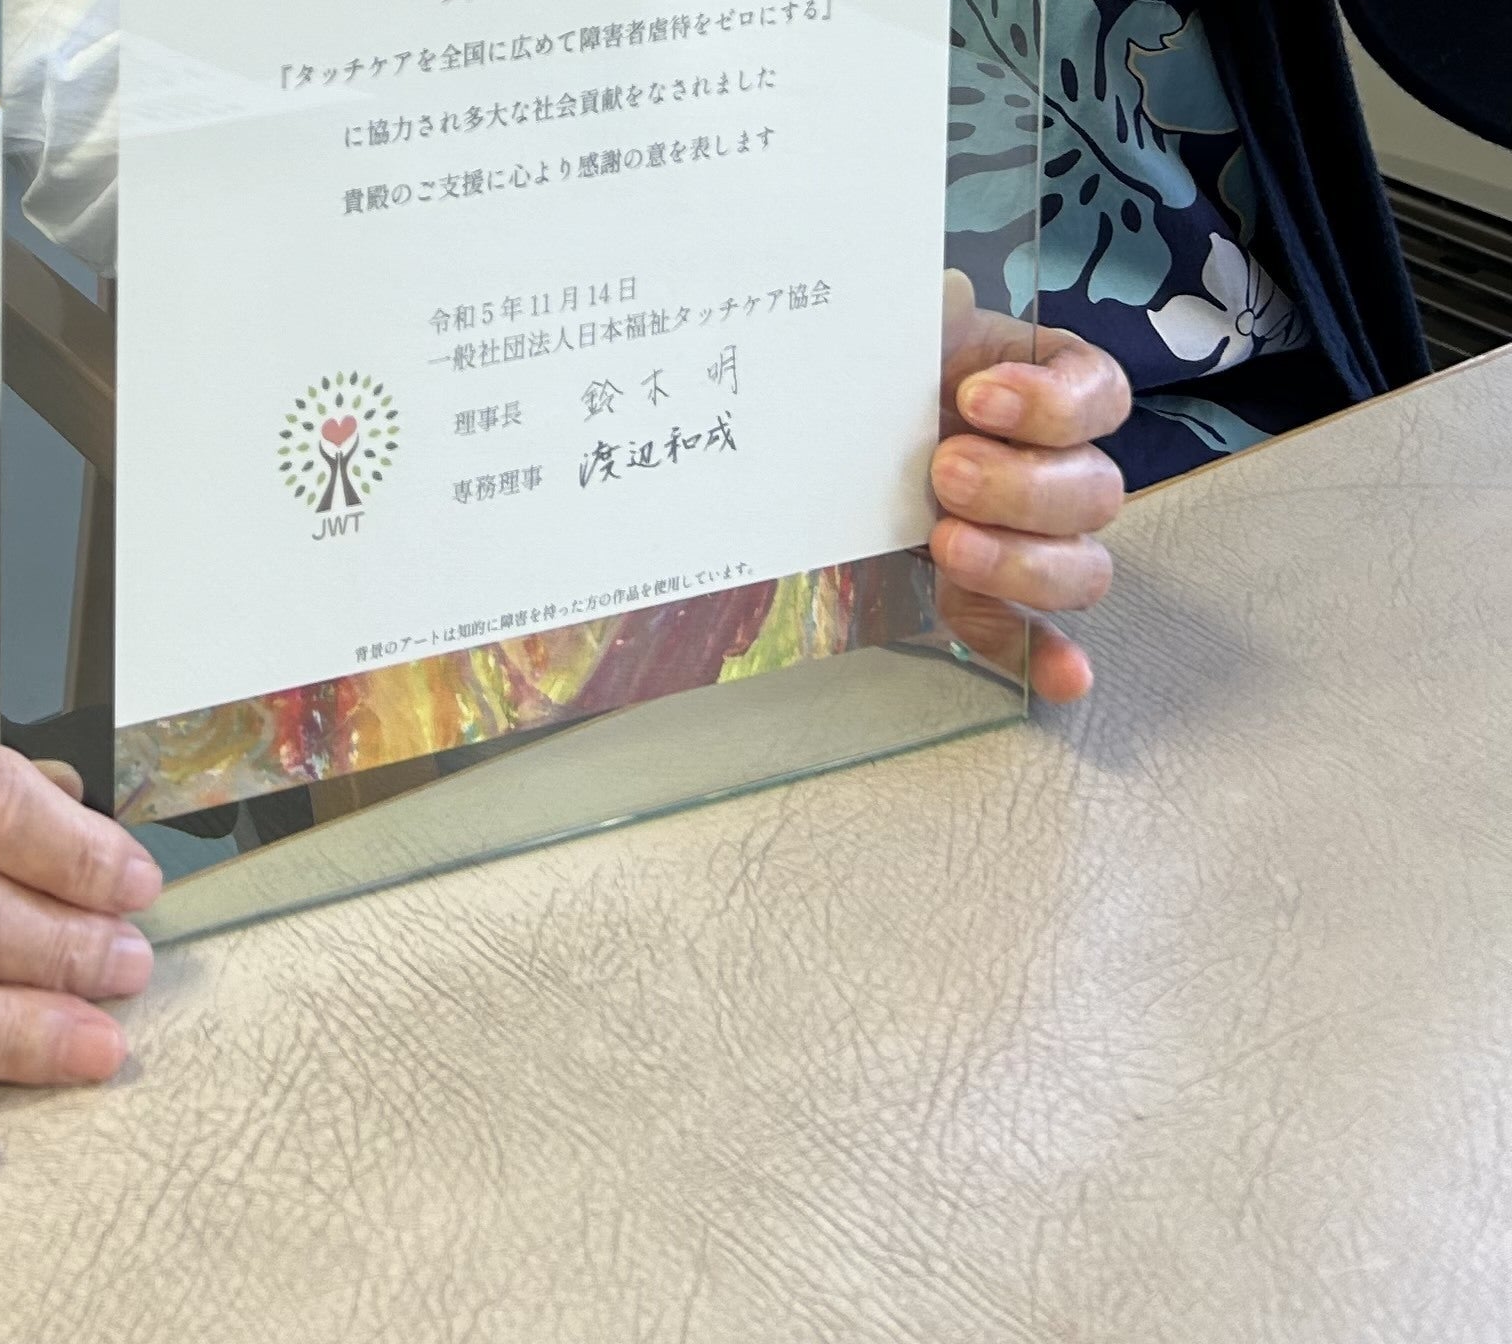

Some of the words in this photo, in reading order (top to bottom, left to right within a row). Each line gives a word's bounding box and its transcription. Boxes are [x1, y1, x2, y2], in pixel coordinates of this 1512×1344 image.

[344, 66, 776, 149] に協力され多大な社会貢献をなされました
[344, 126, 775, 215] 貴殿のご支援に心より感謝の意を表します
[427, 279, 832, 372] 一般社団法人日本福祉タッチケア協会
[454, 401, 522, 435] 理事長
[452, 465, 543, 504] 専務理事
[311, 512, 365, 541] JWT
